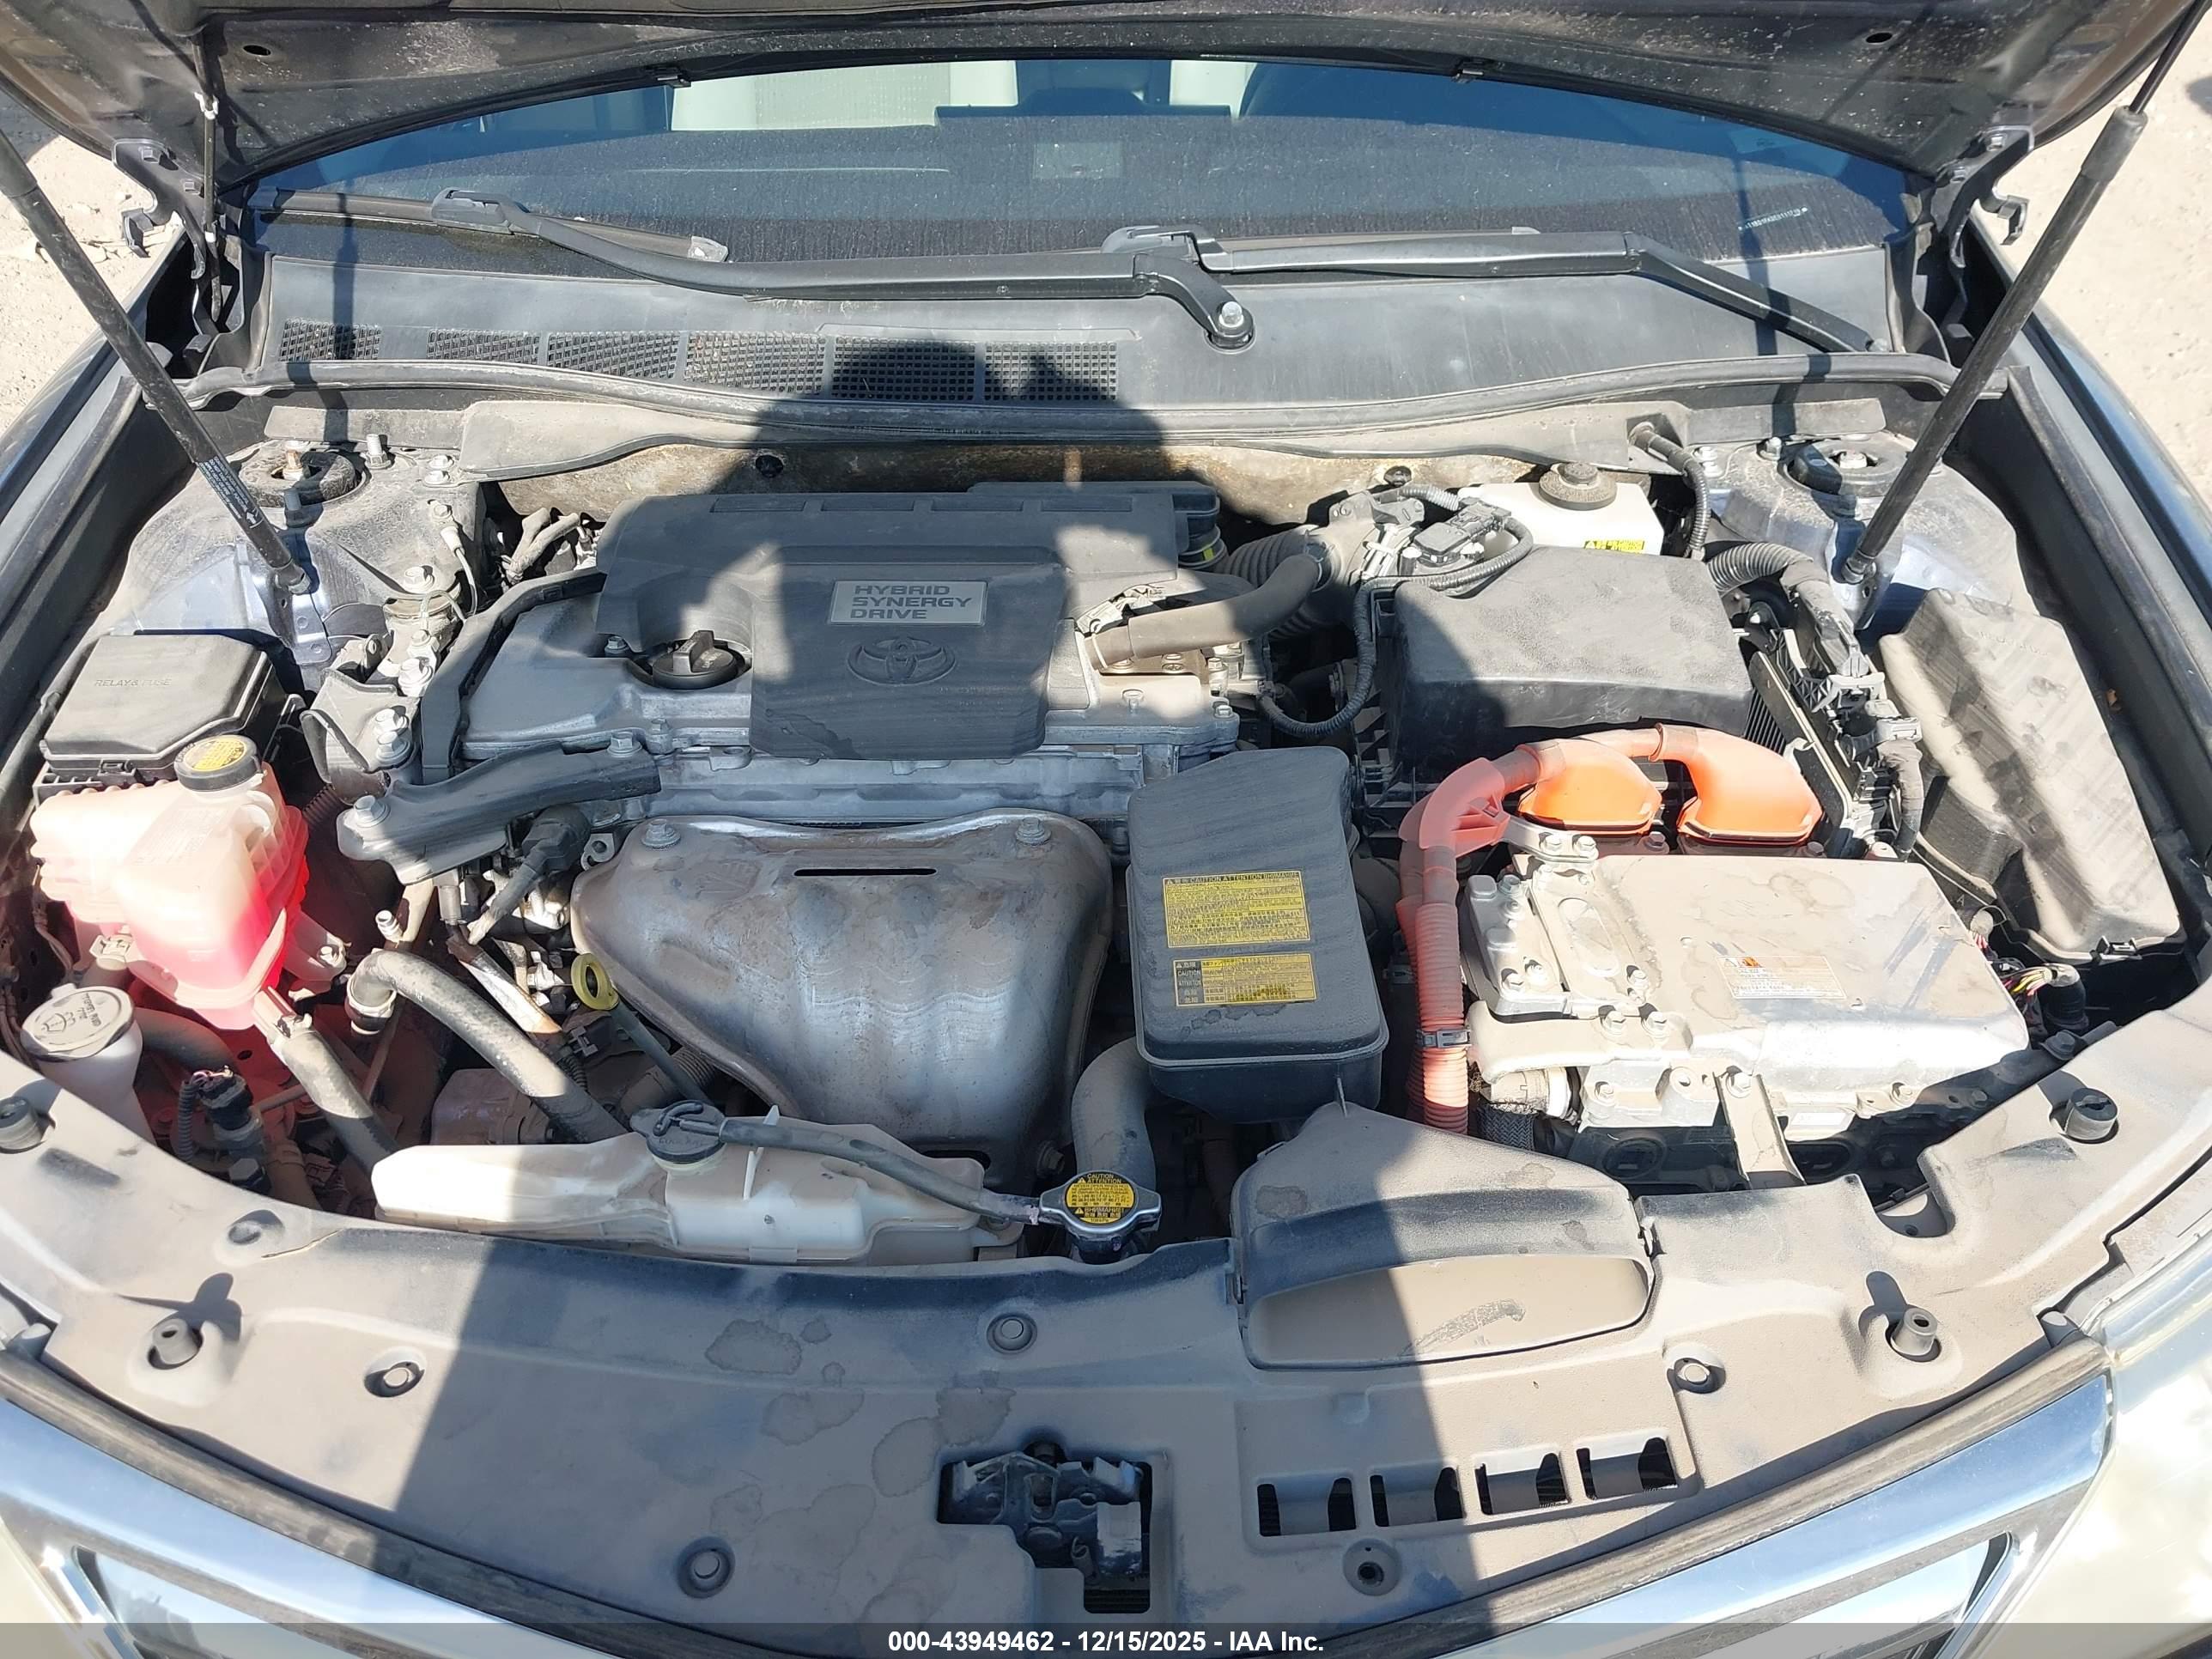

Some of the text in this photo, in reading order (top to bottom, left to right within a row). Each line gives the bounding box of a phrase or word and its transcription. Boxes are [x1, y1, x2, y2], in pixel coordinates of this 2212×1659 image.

[854, 585, 951, 595] HYBRID
[852, 597, 973, 608] SYNERGY
[850, 609, 928, 619] DRIVE
